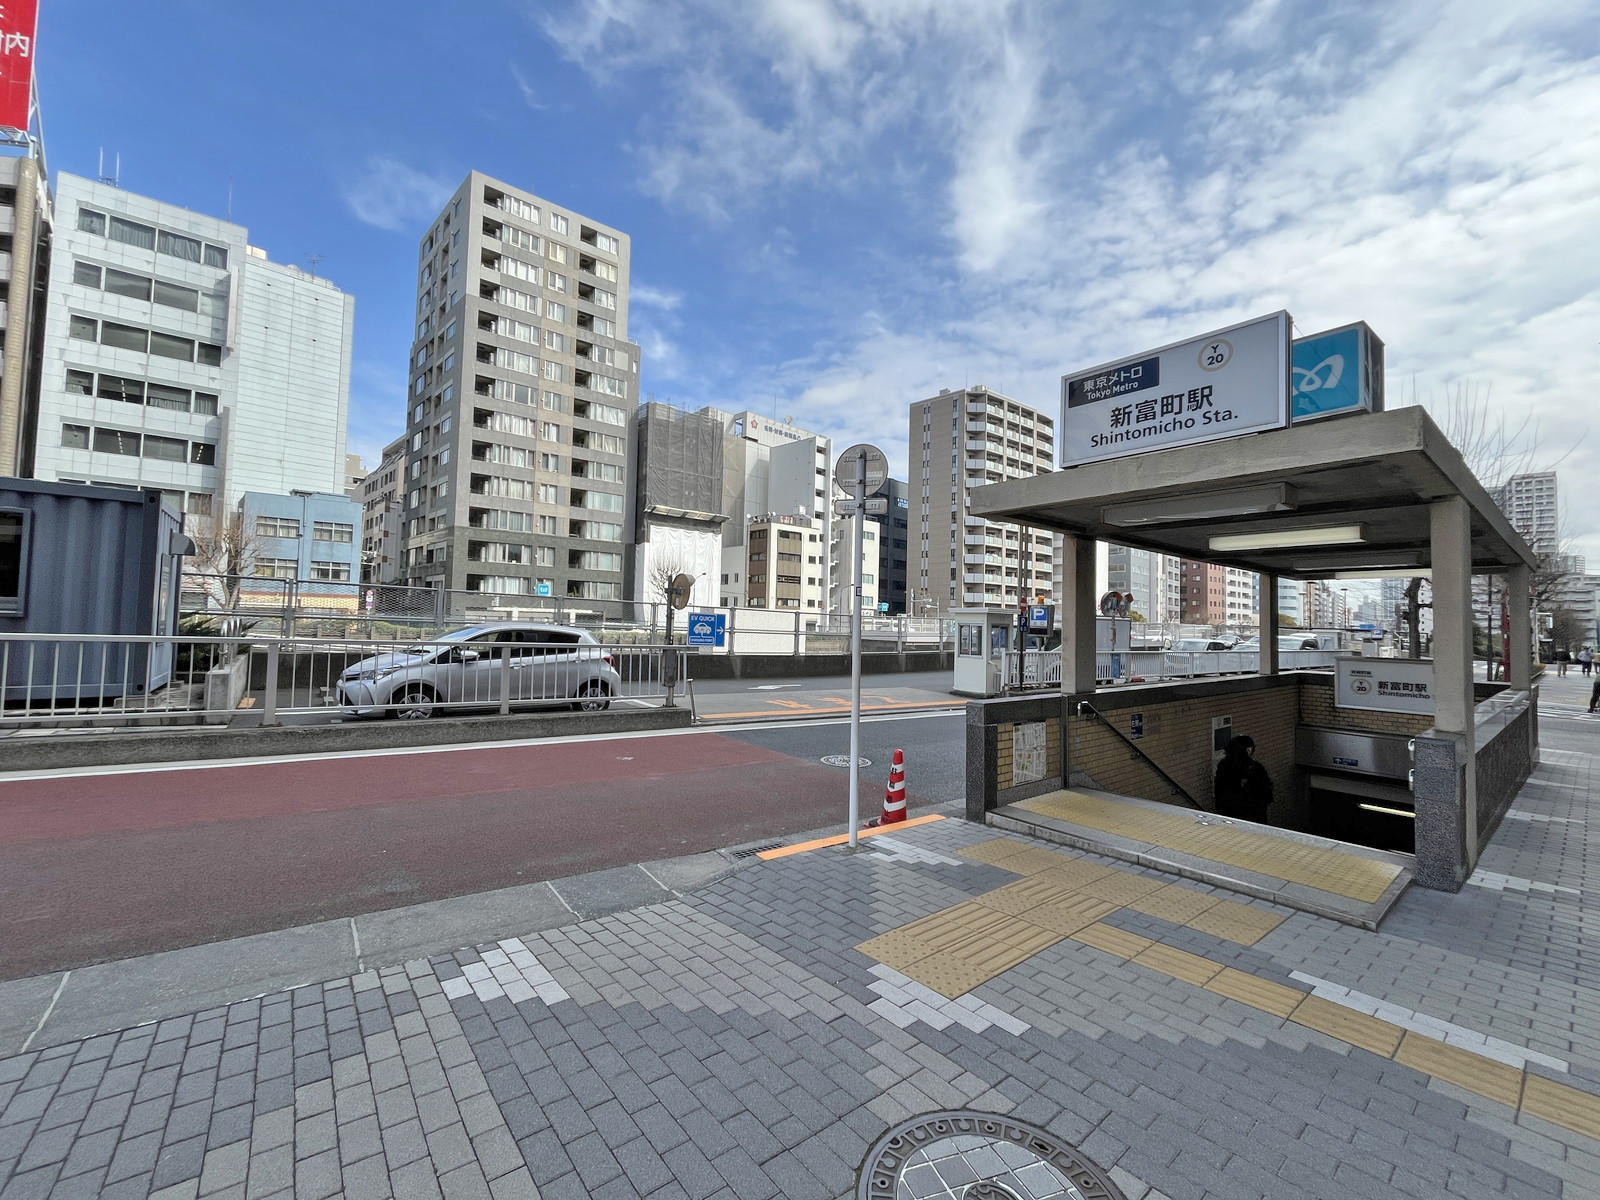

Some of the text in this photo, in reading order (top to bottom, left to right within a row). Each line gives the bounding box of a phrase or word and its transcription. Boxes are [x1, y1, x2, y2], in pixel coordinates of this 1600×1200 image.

[0, 30, 30, 58] 内
[1211, 344, 1220, 354] Y
[1207, 353, 1224, 367] 20
[1083, 365, 1143, 392] 東京メトロ
[1086, 381, 1139, 400] Tokyo Metro
[1110, 384, 1213, 429] 新富町駅
[1090, 409, 1239, 448] Shintomicho Sta.
[1033, 608, 1045, 620] P
[1377, 680, 1428, 693] 新富町駅
[1377, 689, 1431, 700] Shintomicho
